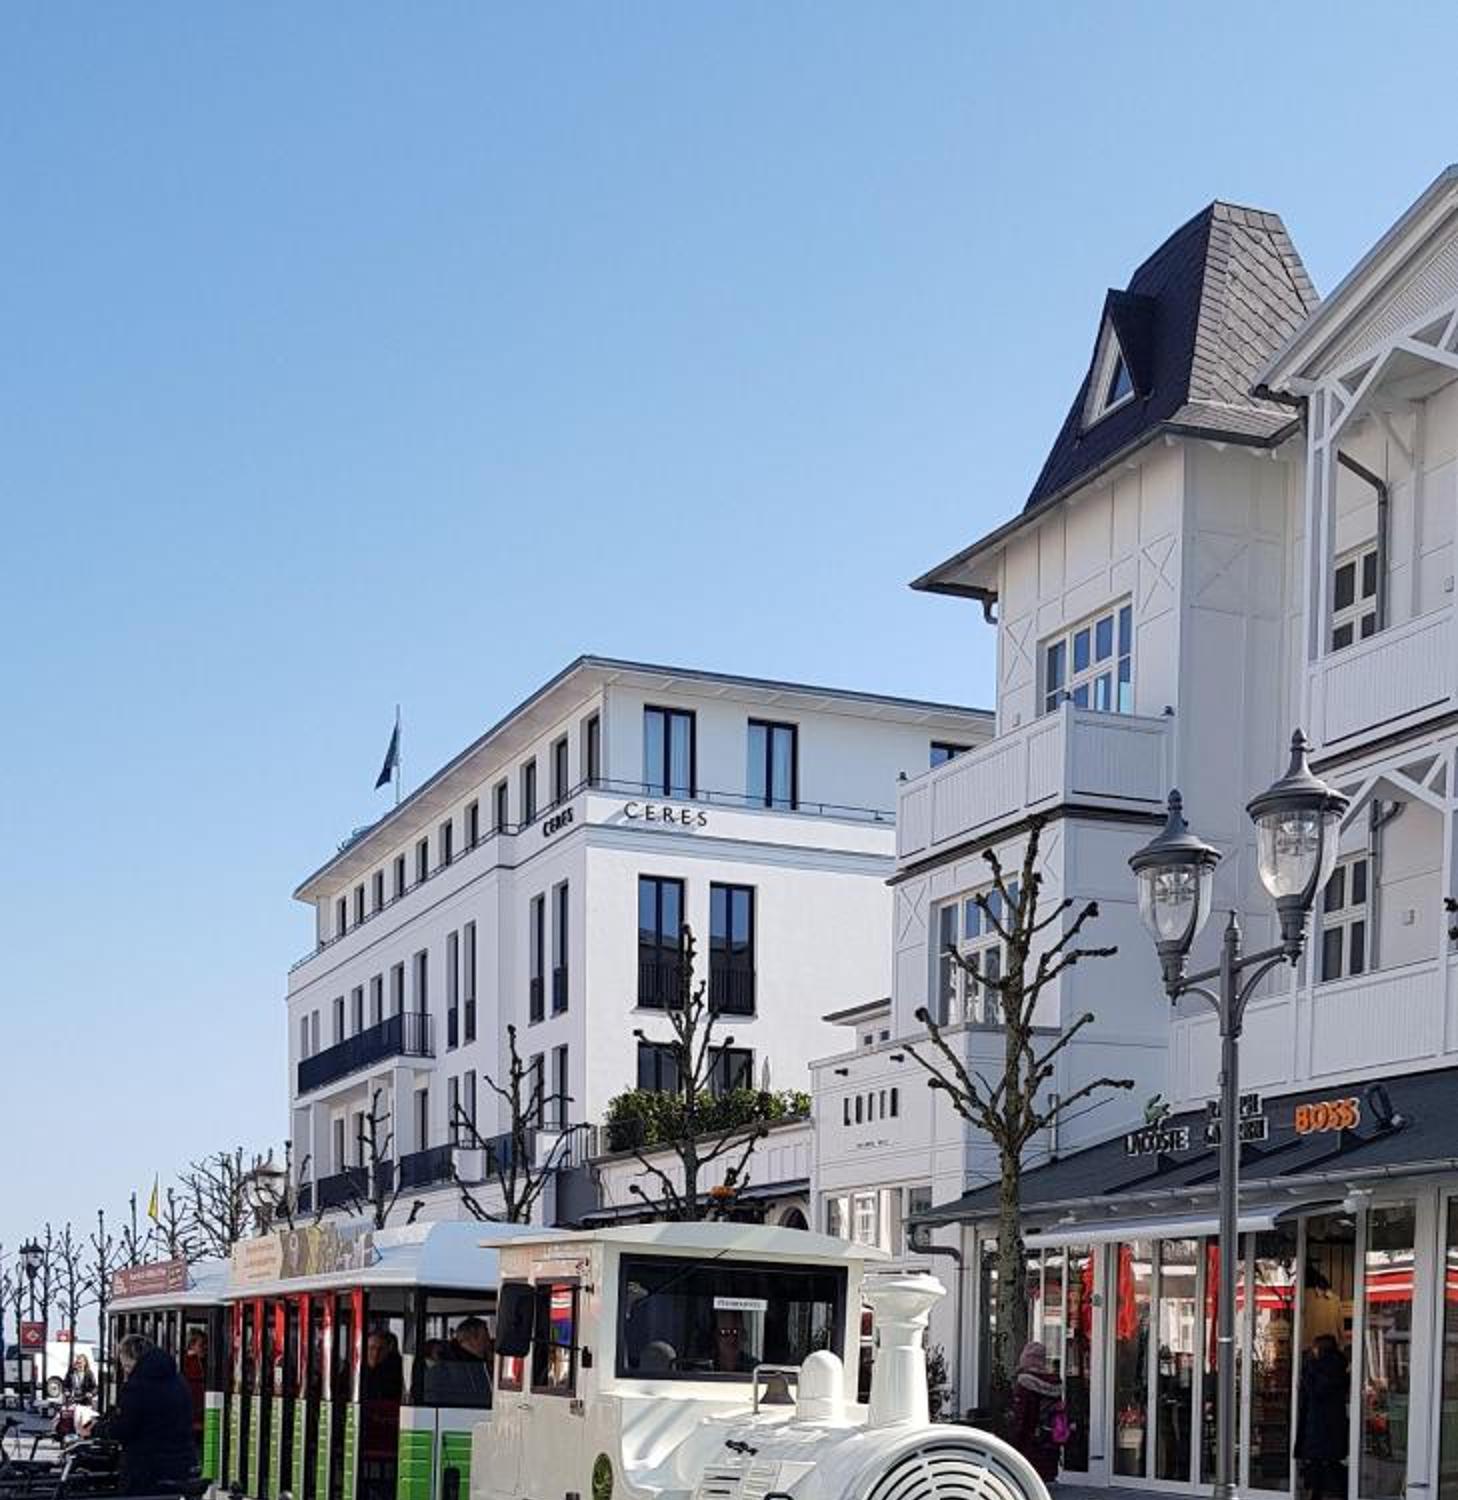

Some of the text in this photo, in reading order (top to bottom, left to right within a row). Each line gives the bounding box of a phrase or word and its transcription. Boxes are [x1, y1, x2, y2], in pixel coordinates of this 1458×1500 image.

[542, 806, 574, 838] CERES
[623, 801, 708, 827] CERES
[1295, 1097, 1361, 1135] BOSS
[1124, 1126, 1190, 1157] LACOSTE
